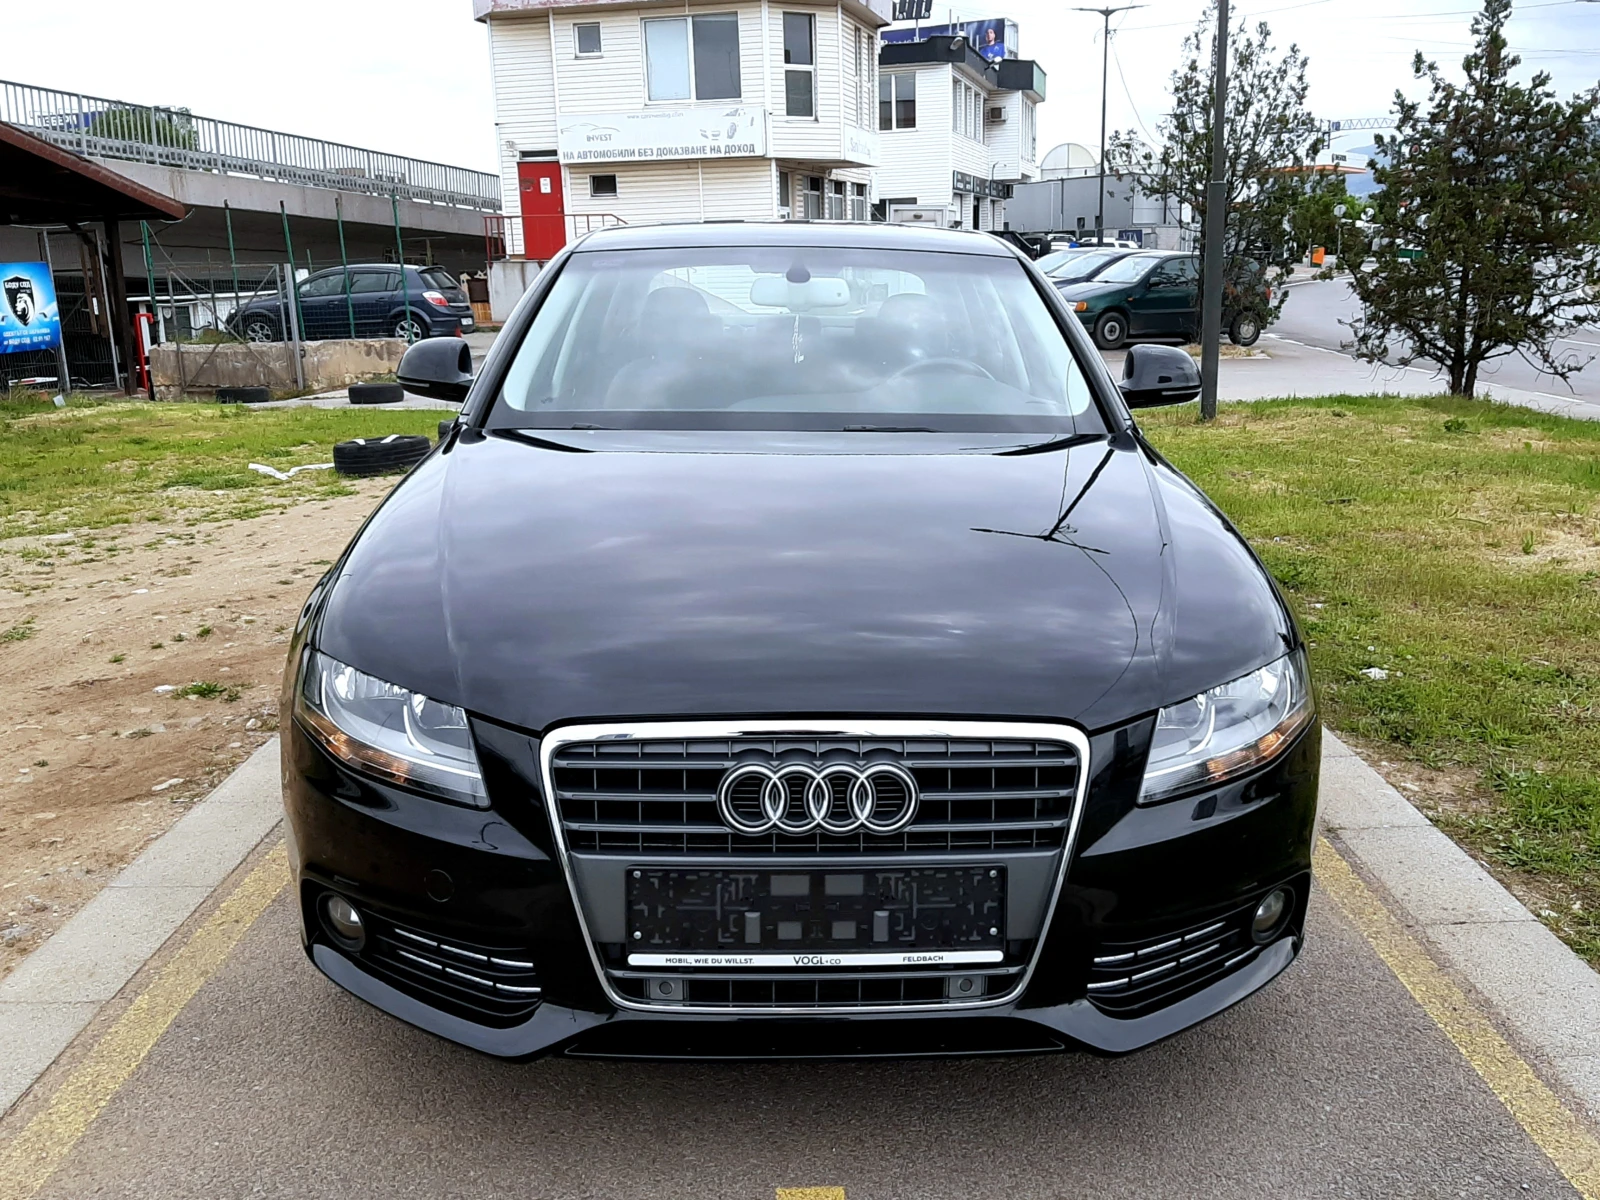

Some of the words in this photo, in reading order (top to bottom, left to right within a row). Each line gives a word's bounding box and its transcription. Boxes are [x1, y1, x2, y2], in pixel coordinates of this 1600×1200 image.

[563, 151, 575, 161] НА
[577, 148, 636, 160] АВТОМОБИЛИ
[637, 147, 654, 158] БЕЗ
[655, 145, 708, 158] ДОКАЗВАНЕ
[710, 144, 722, 155] НА
[724, 143, 756, 156] ДОХОД
[665, 957, 693, 965] MOBIL,
[902, 955, 944, 963] FELDBACH
